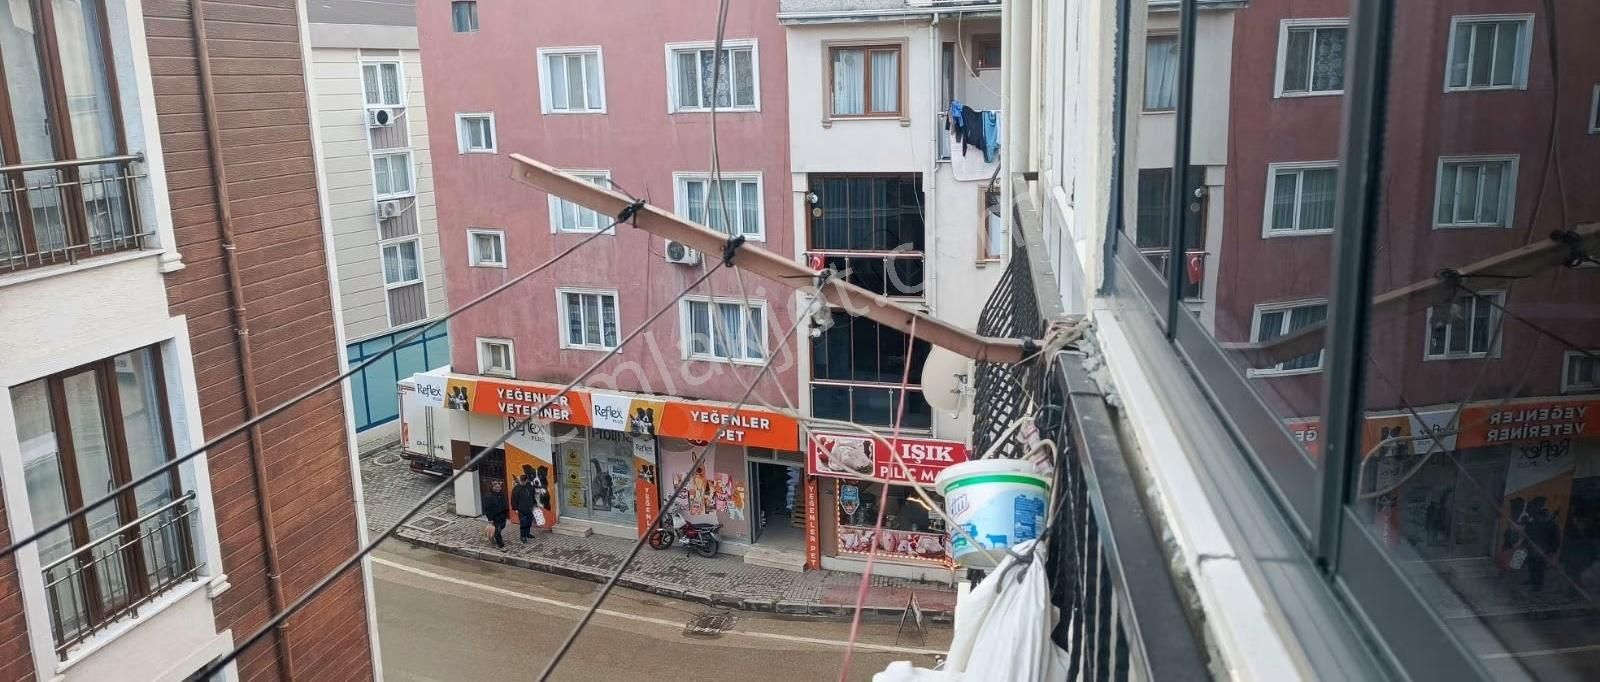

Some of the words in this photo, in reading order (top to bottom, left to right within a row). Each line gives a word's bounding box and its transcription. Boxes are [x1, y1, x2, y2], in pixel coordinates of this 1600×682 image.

[416, 383, 442, 398] Reflex
[497, 388, 568, 406] YEĞENLER
[594, 405, 623, 420] Reflex
[690, 410, 770, 430] YEĞENLER
[716, 429, 744, 442] PET
[901, 443, 954, 464] IŞIK
